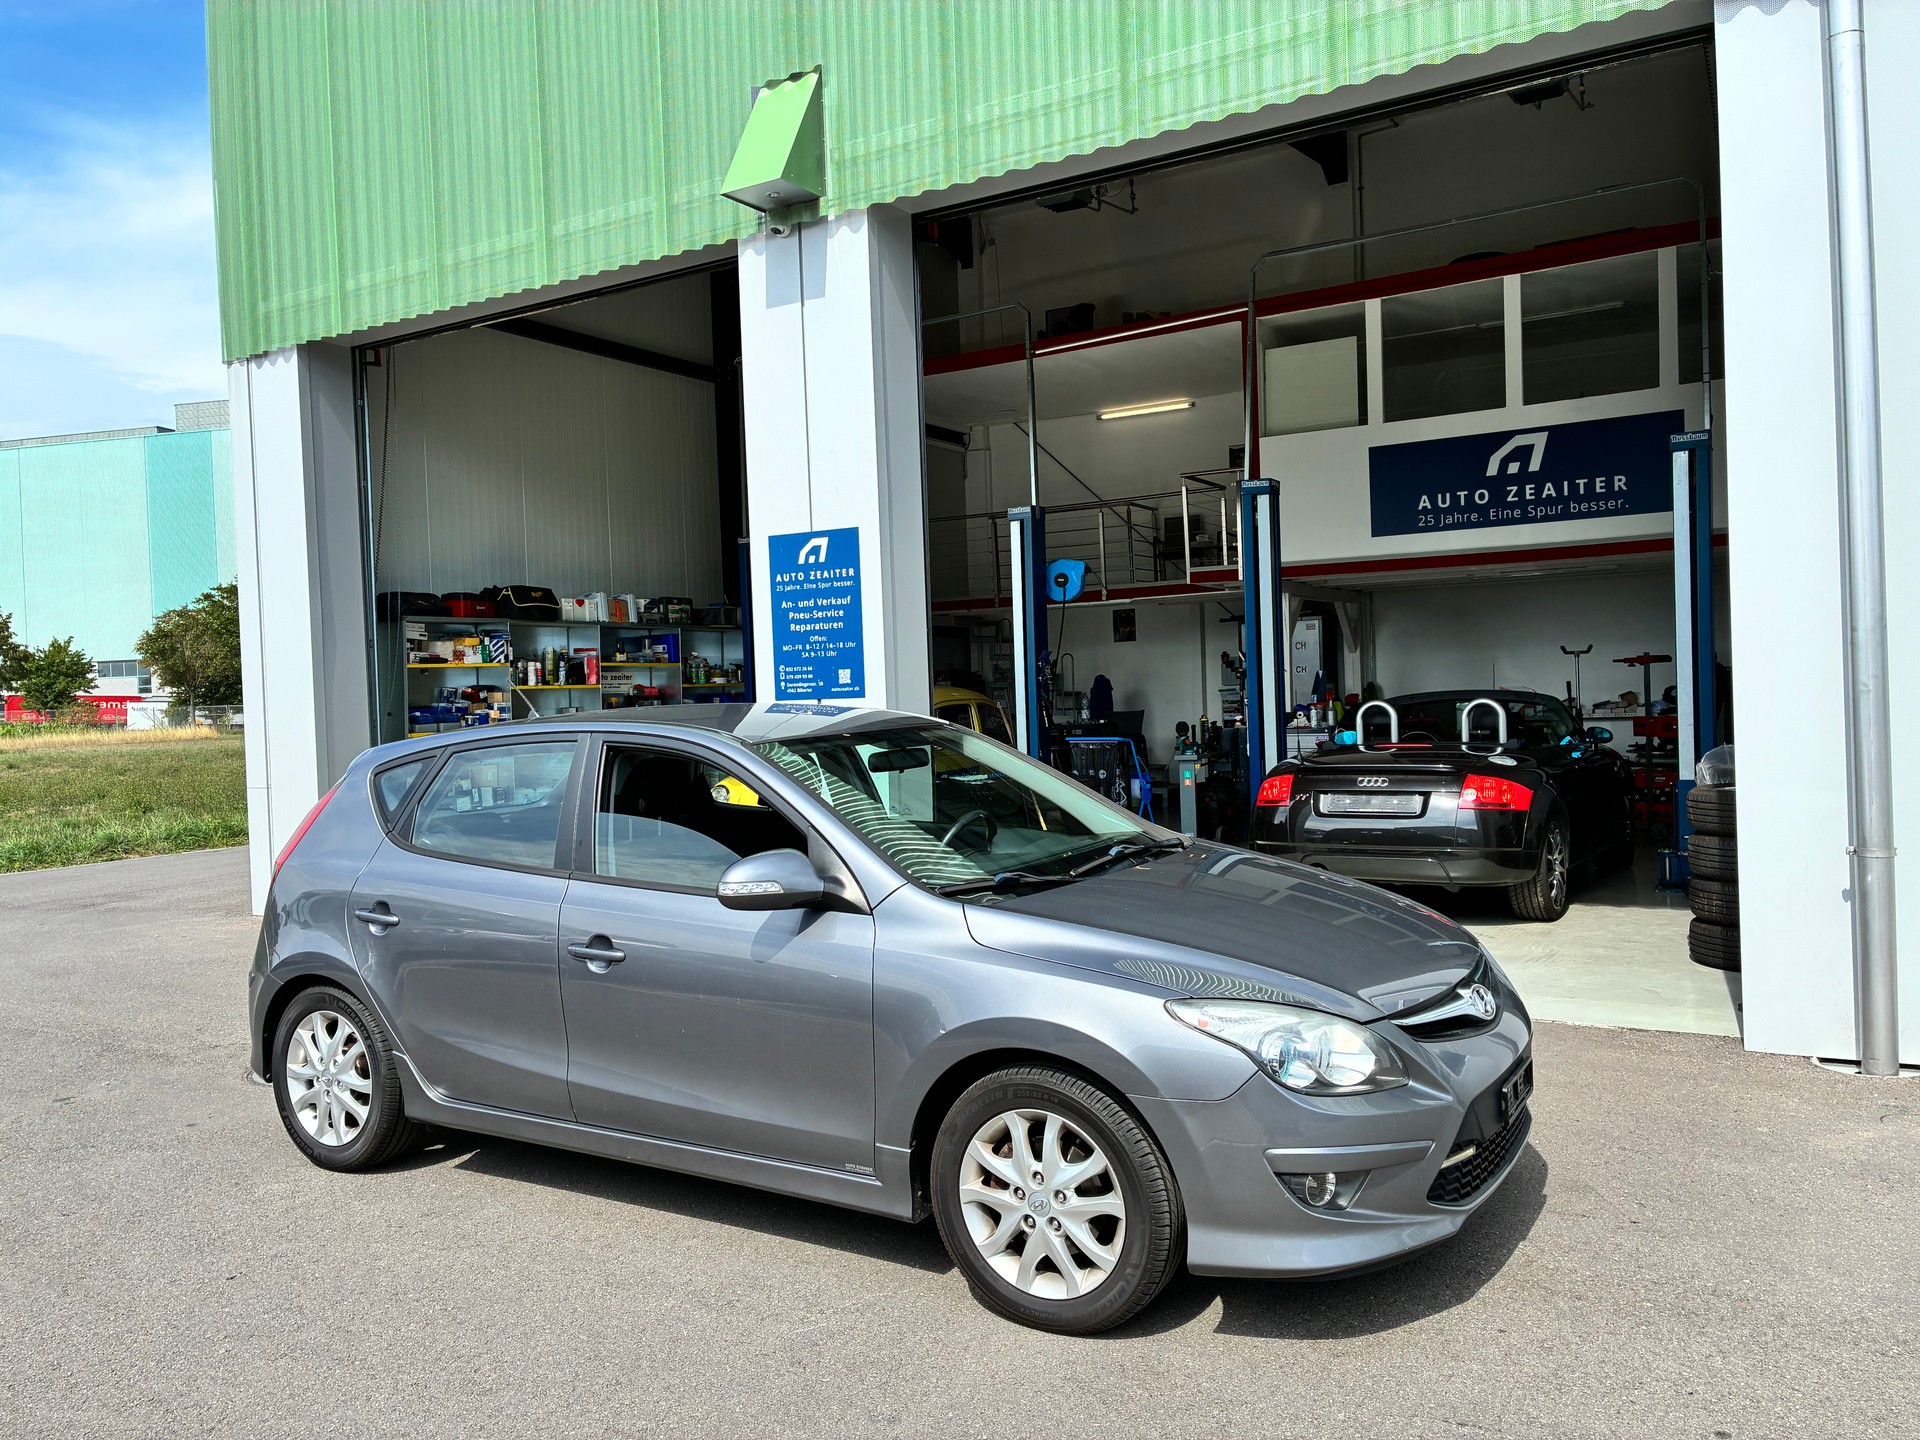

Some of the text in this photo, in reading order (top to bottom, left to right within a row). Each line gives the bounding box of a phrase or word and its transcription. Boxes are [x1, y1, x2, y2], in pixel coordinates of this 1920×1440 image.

[1418, 475, 1628, 510] AUTO ZEAITER
[1418, 498, 1629, 527] 25 Jahre. Eine Spur besser.
[776, 568, 855, 583] AUTO ZEAITER
[785, 584, 802, 592] Jahre.
[781, 595, 851, 609] An- und Verkauf
[789, 609, 844, 620] Pneu-Service
[790, 622, 844, 633] Reparaturen
[1295, 641, 1307, 650] CH
[1295, 665, 1307, 674] CH
[610, 673, 632, 681] zeaiter
[337, 1001, 369, 1038] MICHELIN
